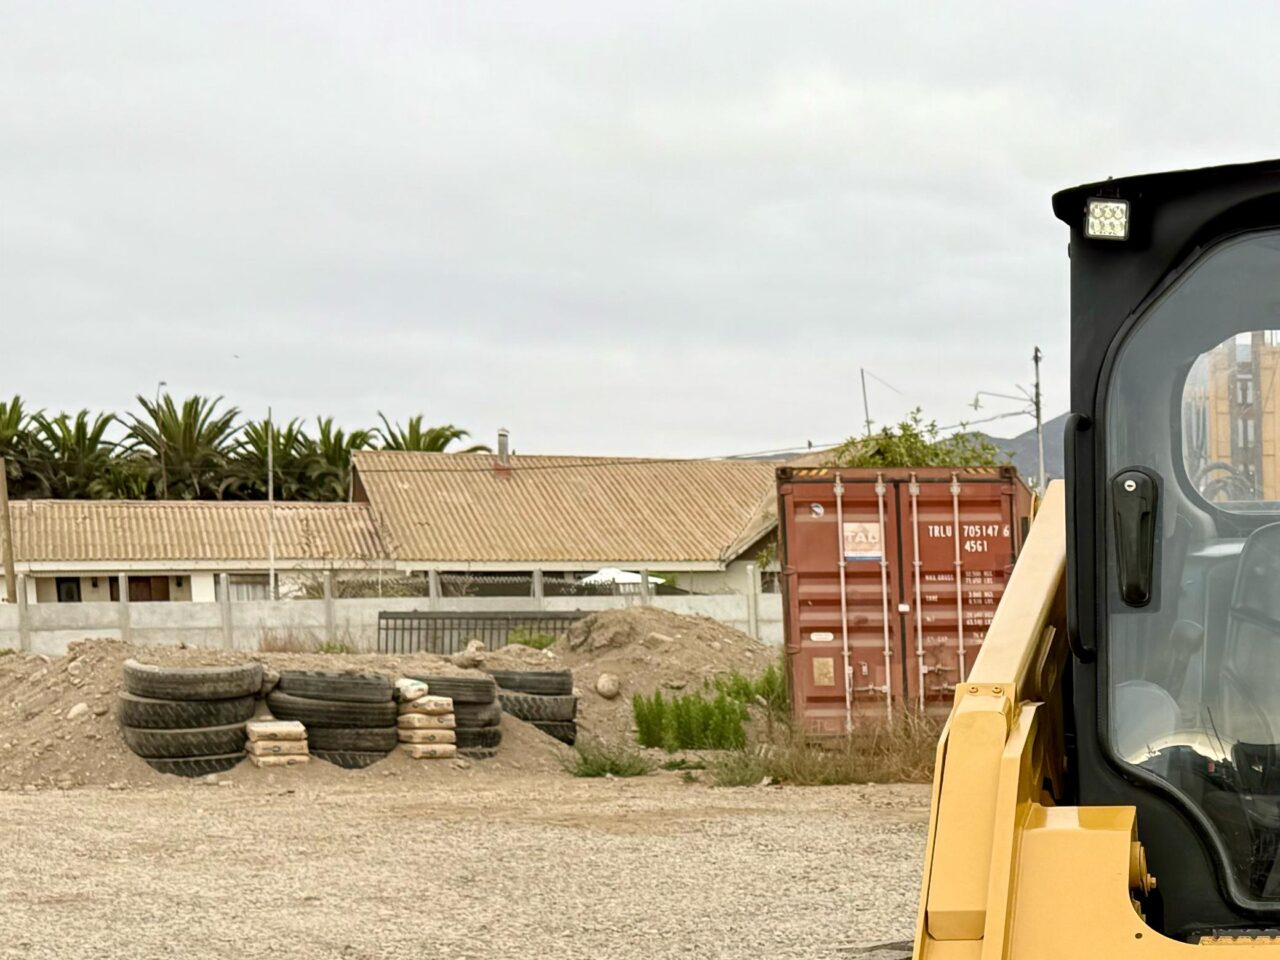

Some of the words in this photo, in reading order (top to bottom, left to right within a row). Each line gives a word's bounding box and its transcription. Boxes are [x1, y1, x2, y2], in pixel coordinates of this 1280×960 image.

[928, 525, 952, 537] TRLU
[963, 525, 999, 537] 705147
[1003, 525, 1010, 537] 6
